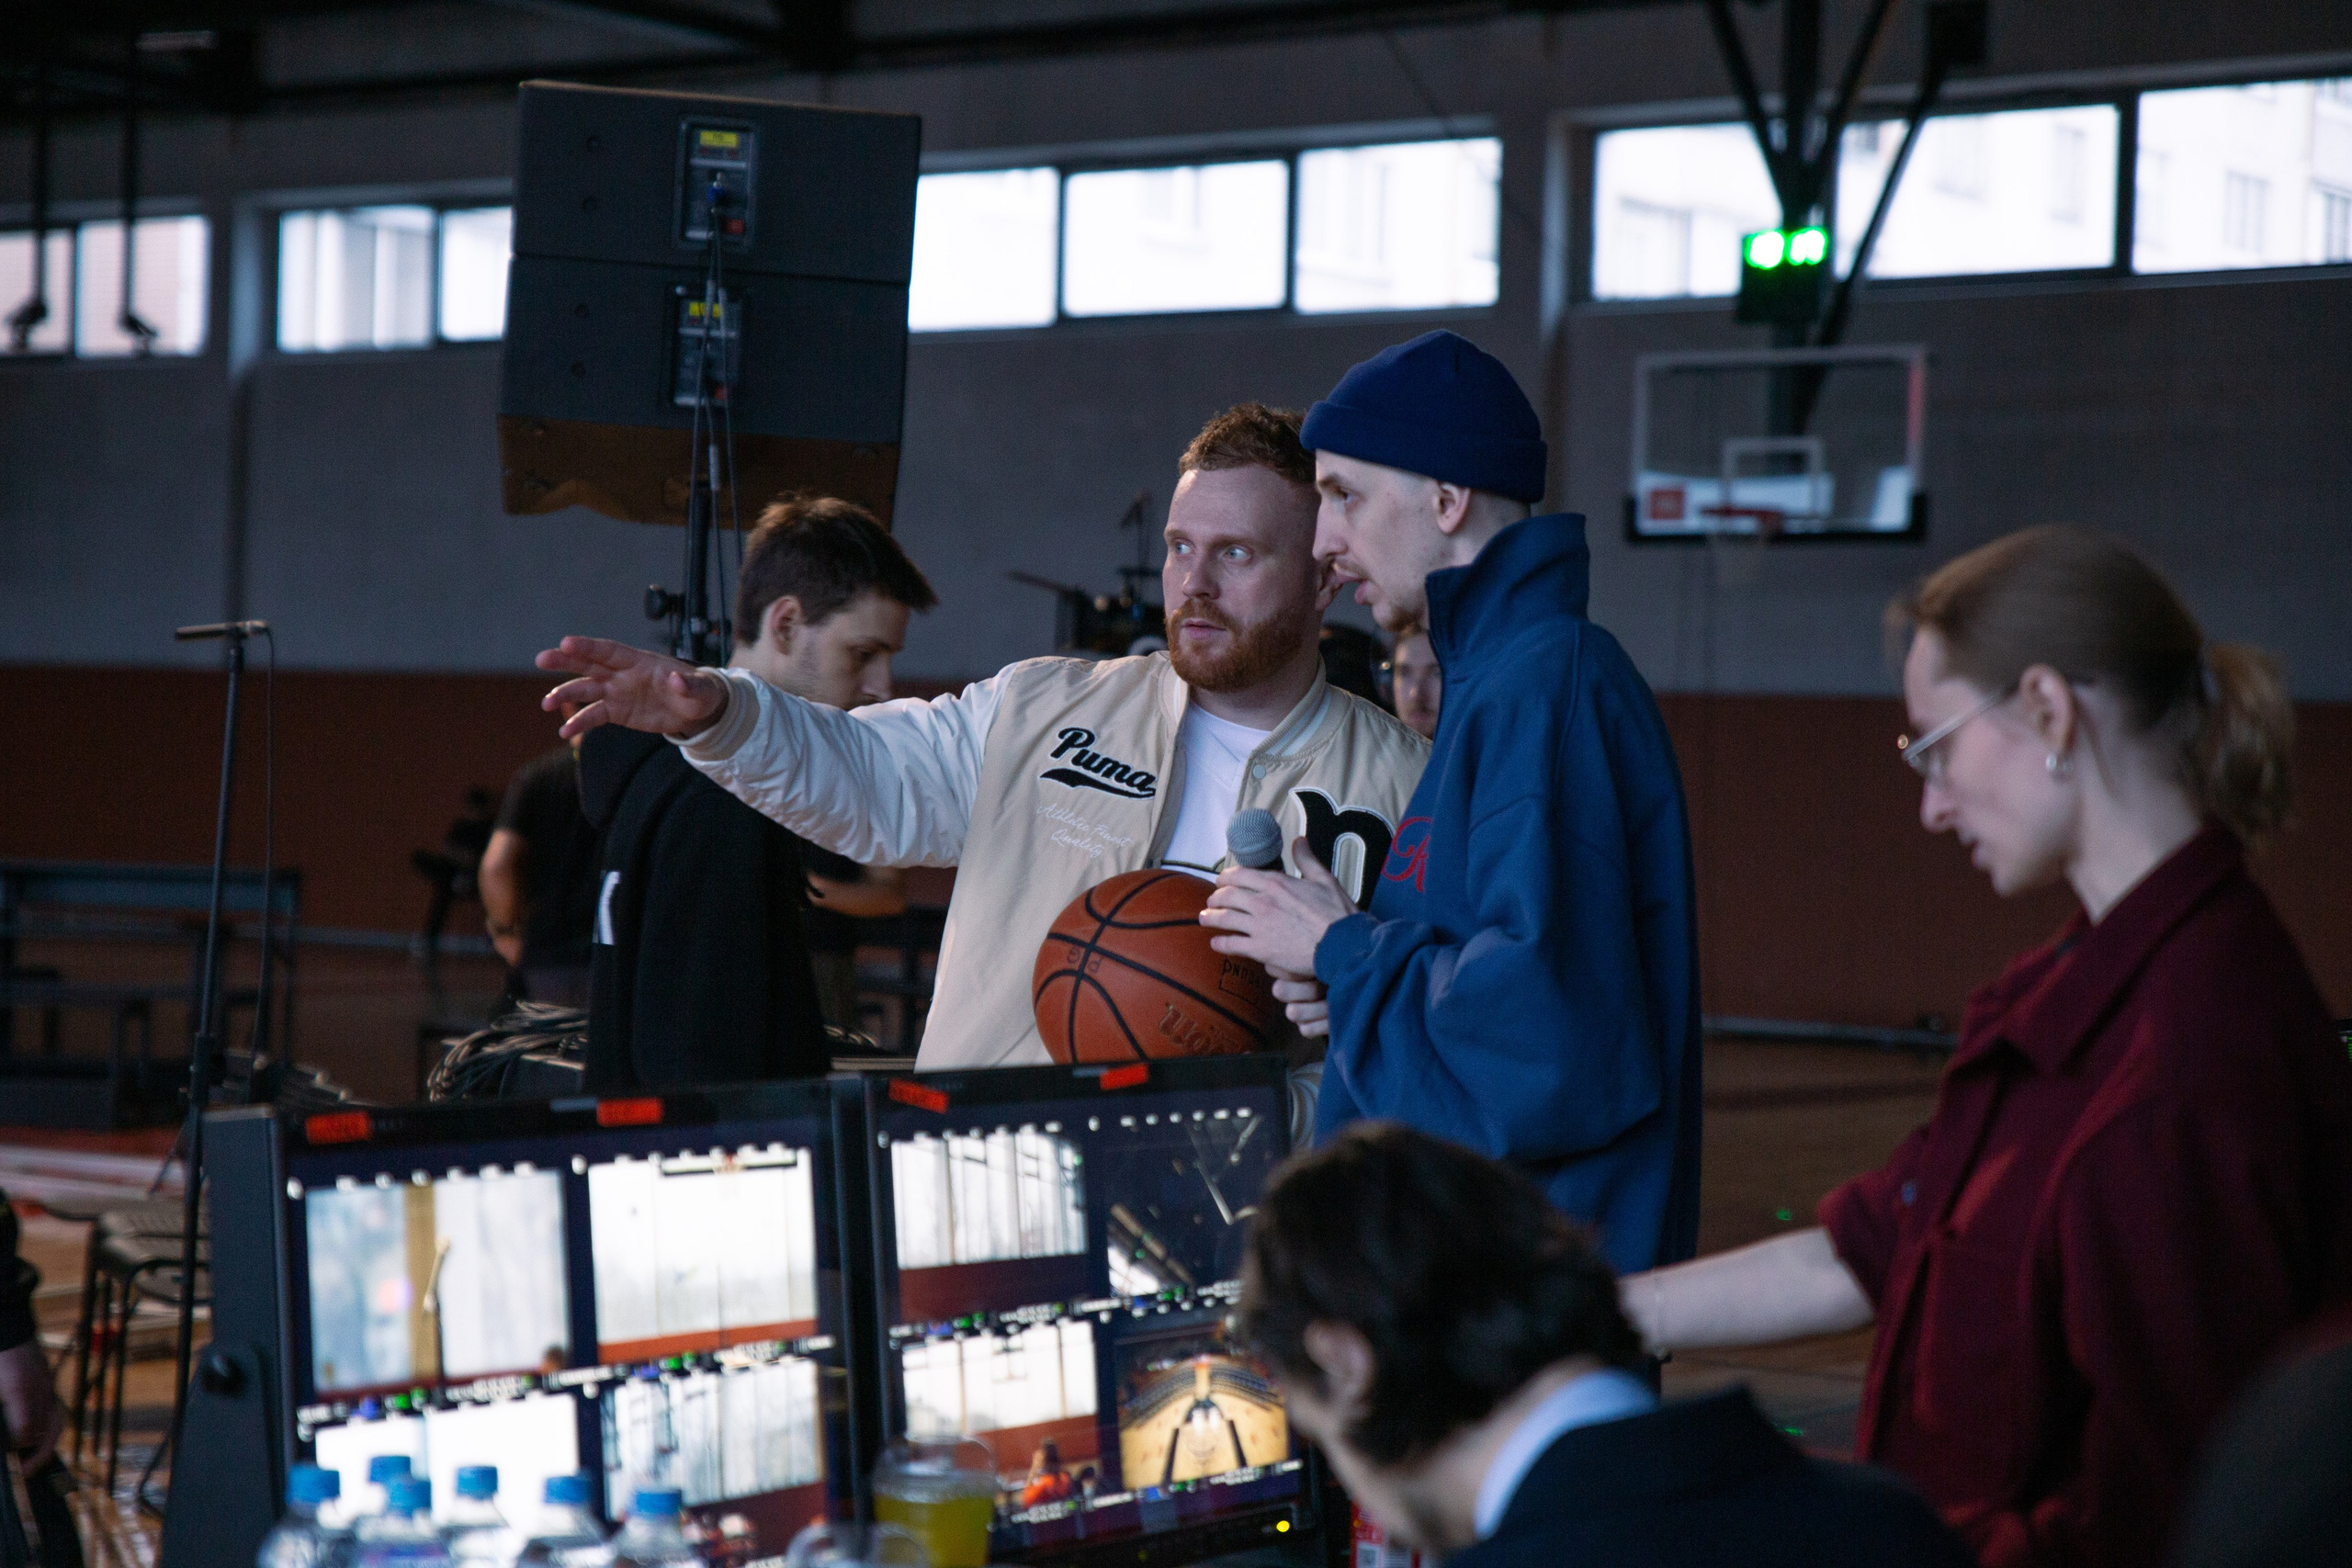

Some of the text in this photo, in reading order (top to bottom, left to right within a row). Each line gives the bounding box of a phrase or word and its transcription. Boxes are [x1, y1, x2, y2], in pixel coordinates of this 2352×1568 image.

[1049, 726, 1157, 793] Puma
[1035, 803, 1090, 831] Athletic
[1050, 829, 1104, 859] Quality
